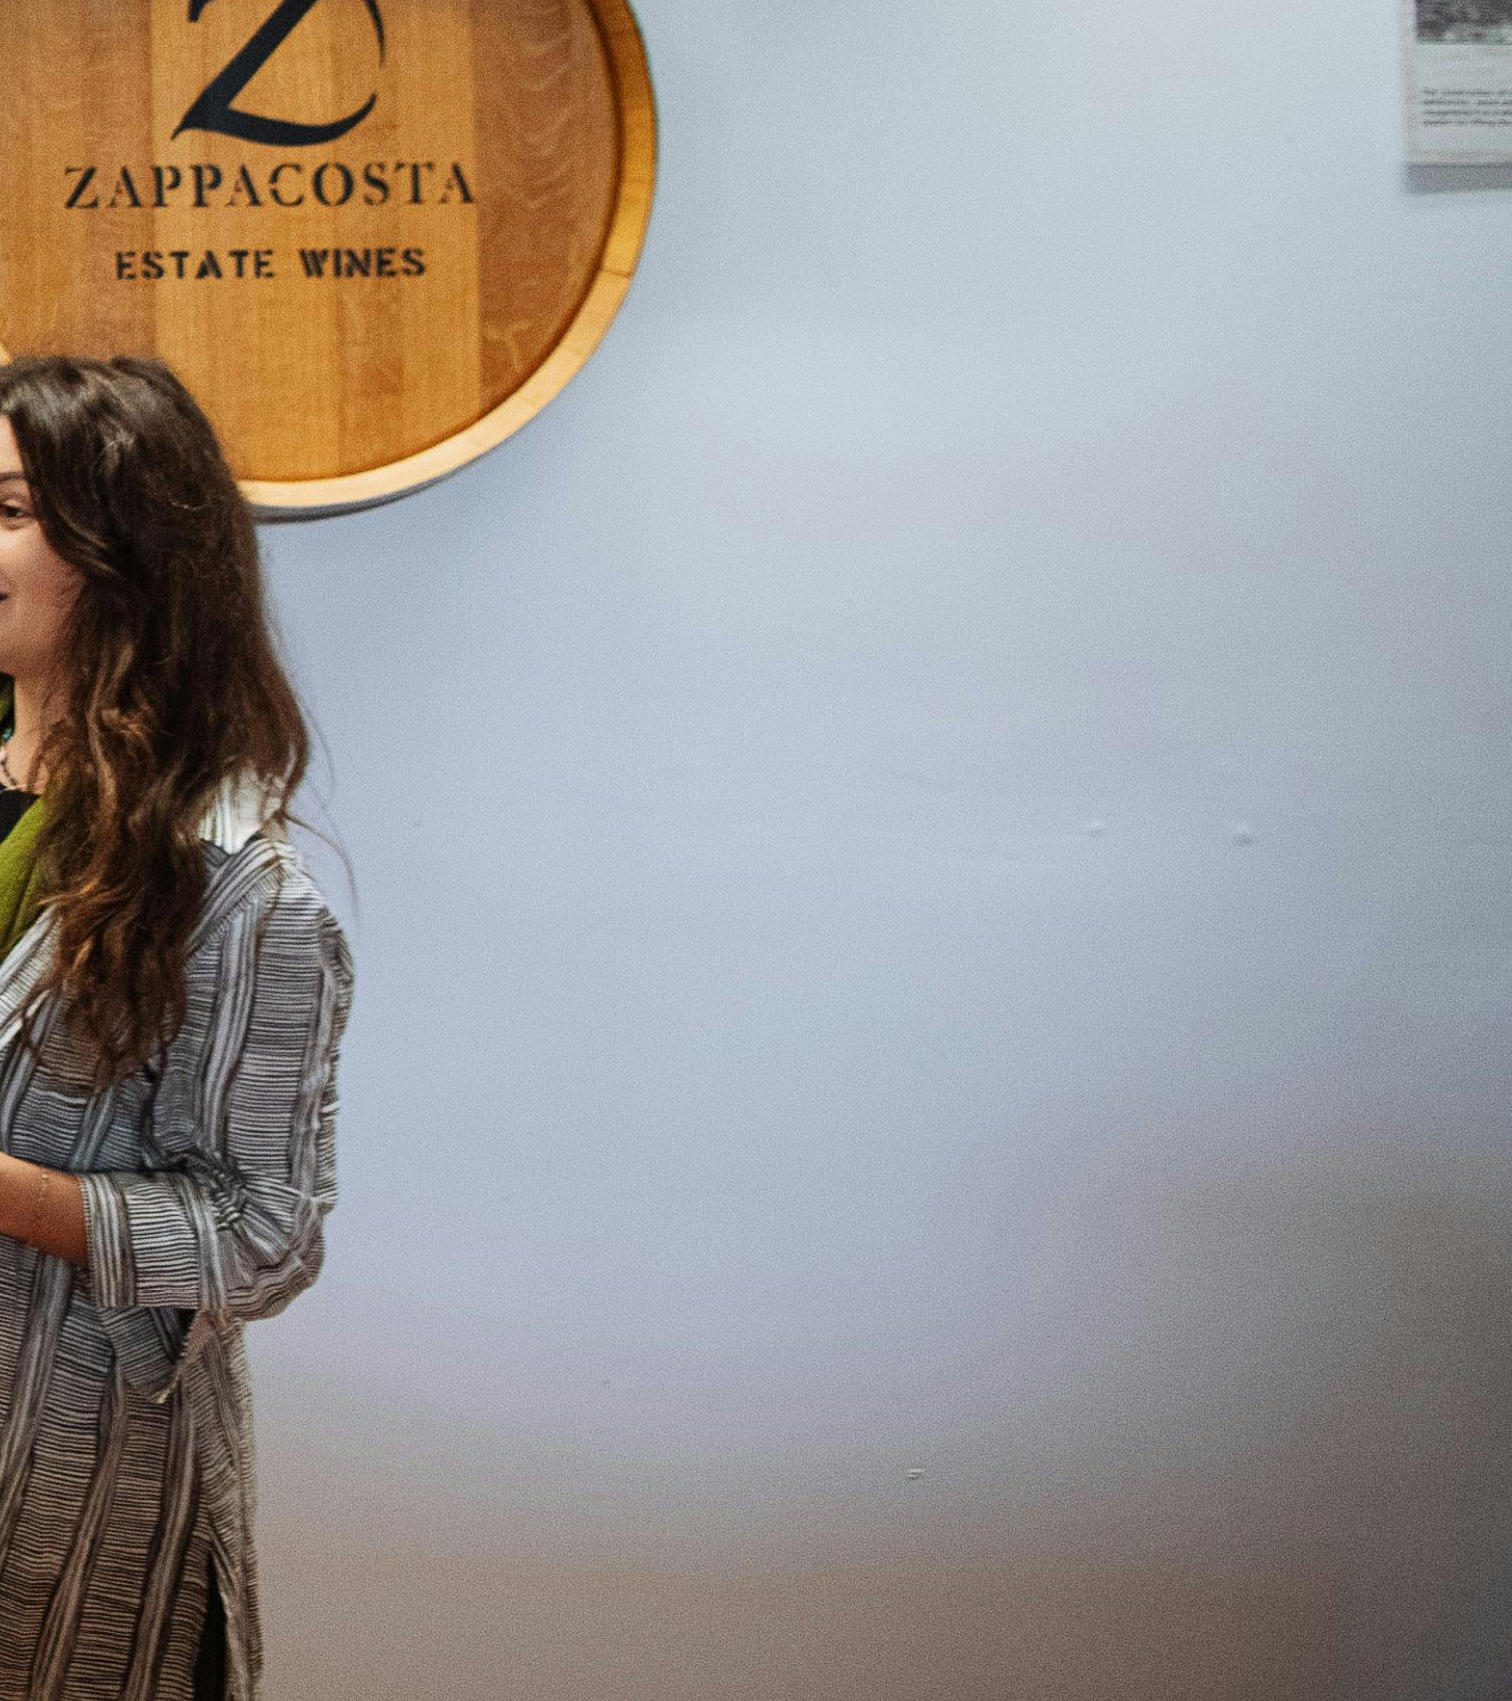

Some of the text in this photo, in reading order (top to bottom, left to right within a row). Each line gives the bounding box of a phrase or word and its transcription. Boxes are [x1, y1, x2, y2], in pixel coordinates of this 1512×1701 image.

[64, 160, 476, 210] ZAPPACOSTA
[116, 247, 426, 281] ESTATE WINES
